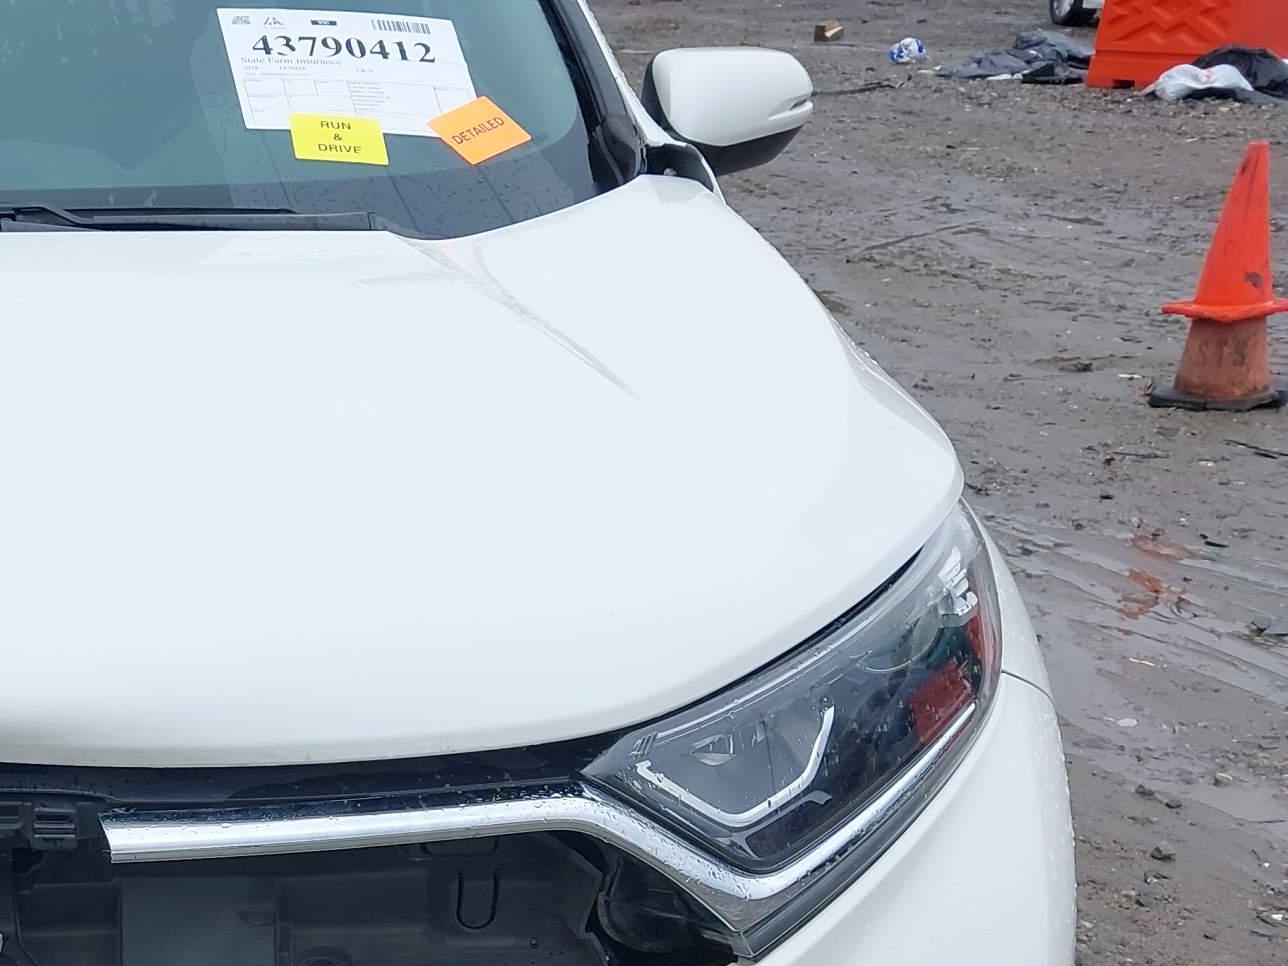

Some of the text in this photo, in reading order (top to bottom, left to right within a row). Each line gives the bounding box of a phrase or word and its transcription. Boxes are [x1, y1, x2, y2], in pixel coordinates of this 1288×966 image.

[252, 34, 436, 64] 43790412
[320, 120, 352, 130] RUN
[451, 117, 505, 145] DETAILED
[334, 133, 343, 141] &
[318, 143, 362, 154] DRIVE
